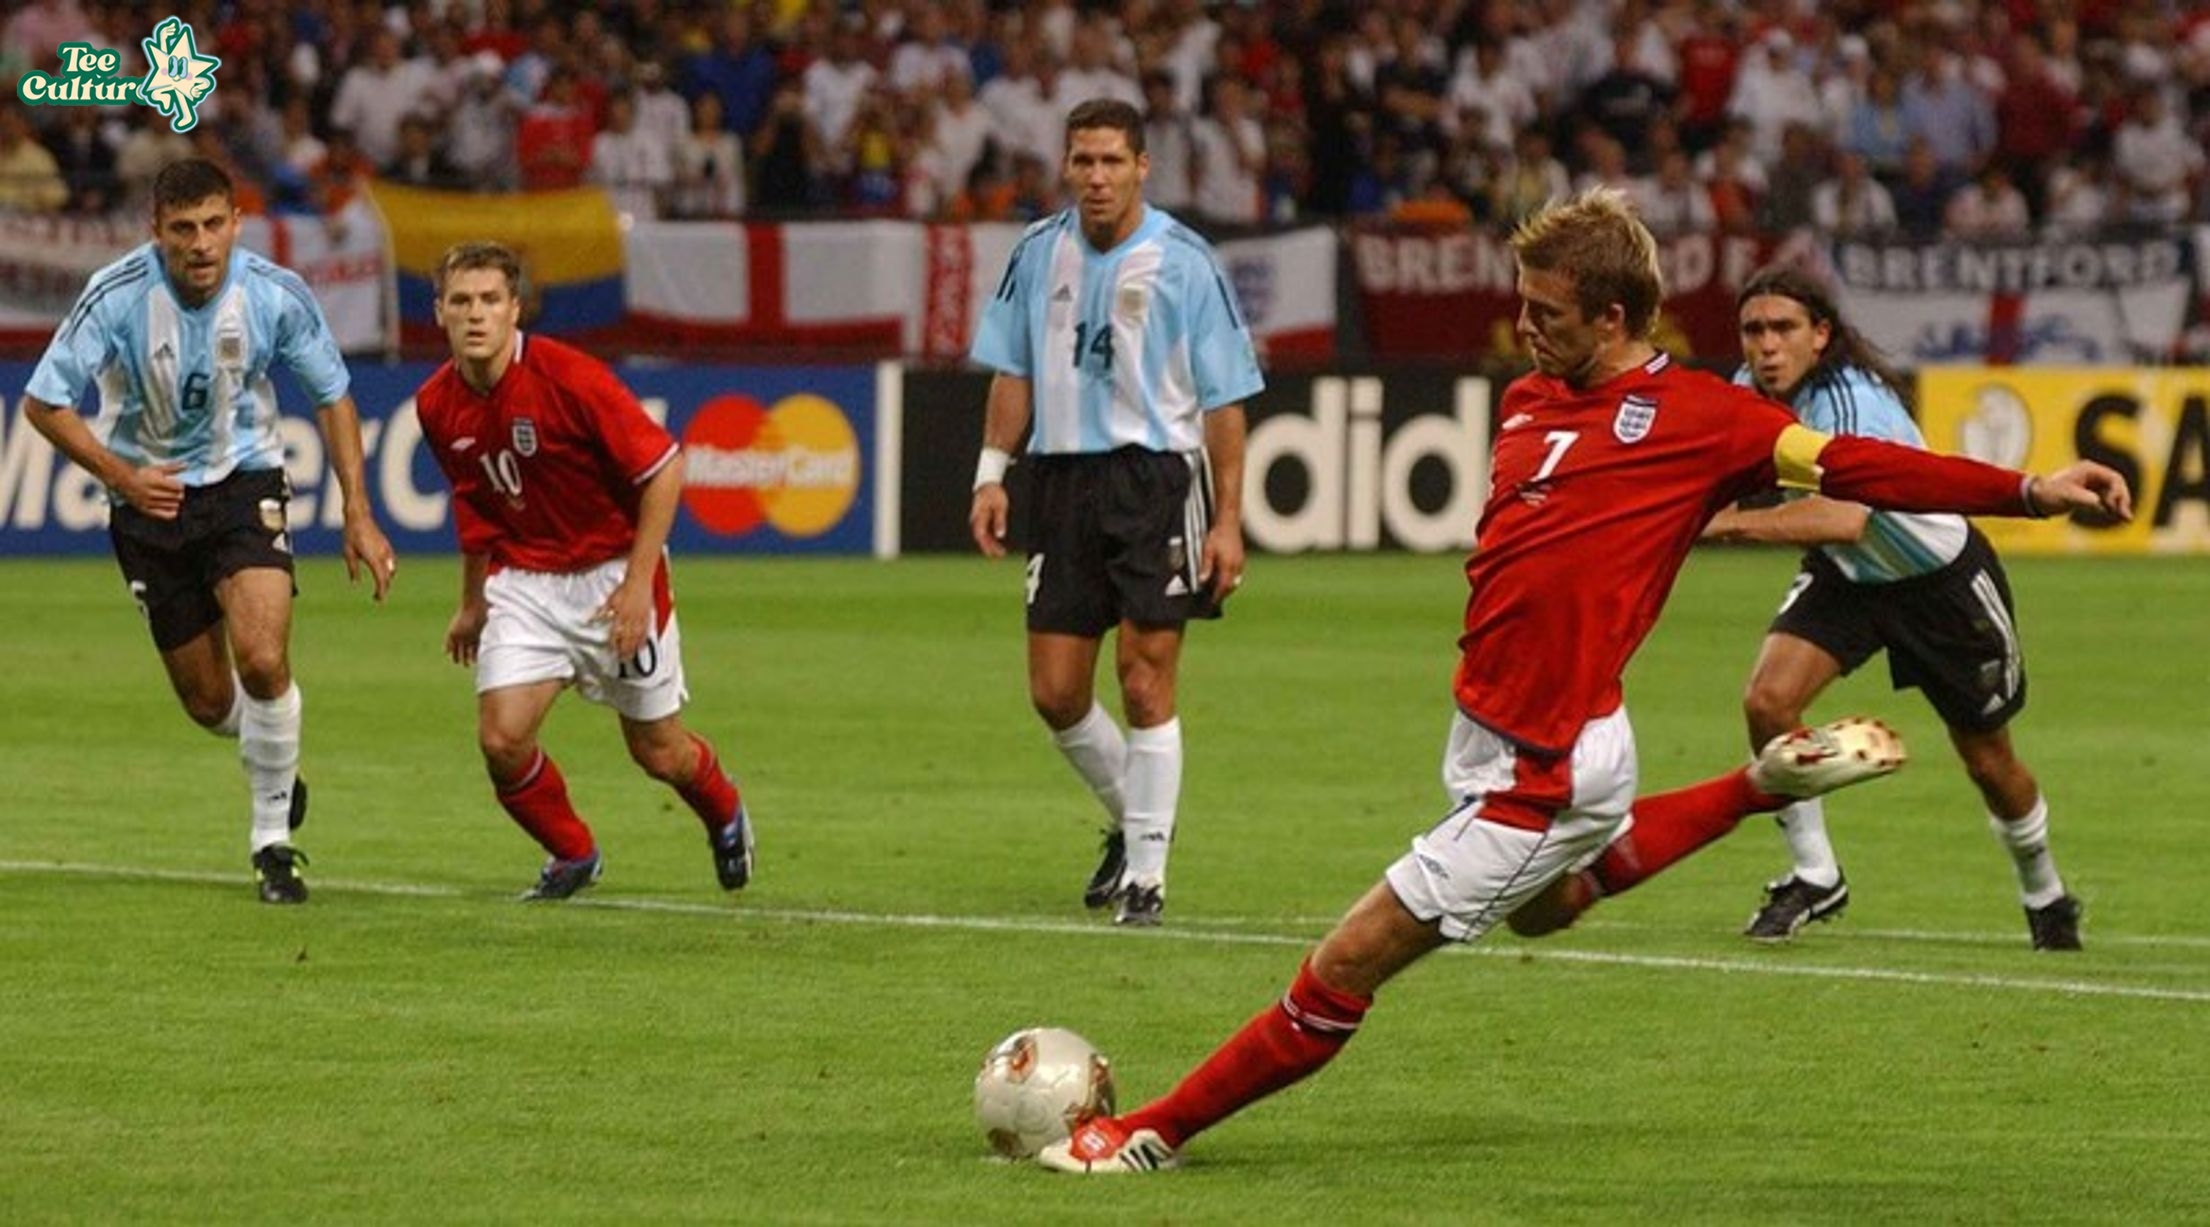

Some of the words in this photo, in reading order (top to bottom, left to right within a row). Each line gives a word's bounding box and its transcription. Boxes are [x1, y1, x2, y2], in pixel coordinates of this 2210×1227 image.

[1842, 241, 2180, 290] BRENTFORD
[1073, 320, 1115, 370] 14
[182, 372, 210, 411] 6
[479, 449, 522, 496] 10
[1241, 376, 1491, 553] did
[1530, 431, 1579, 483] 7
